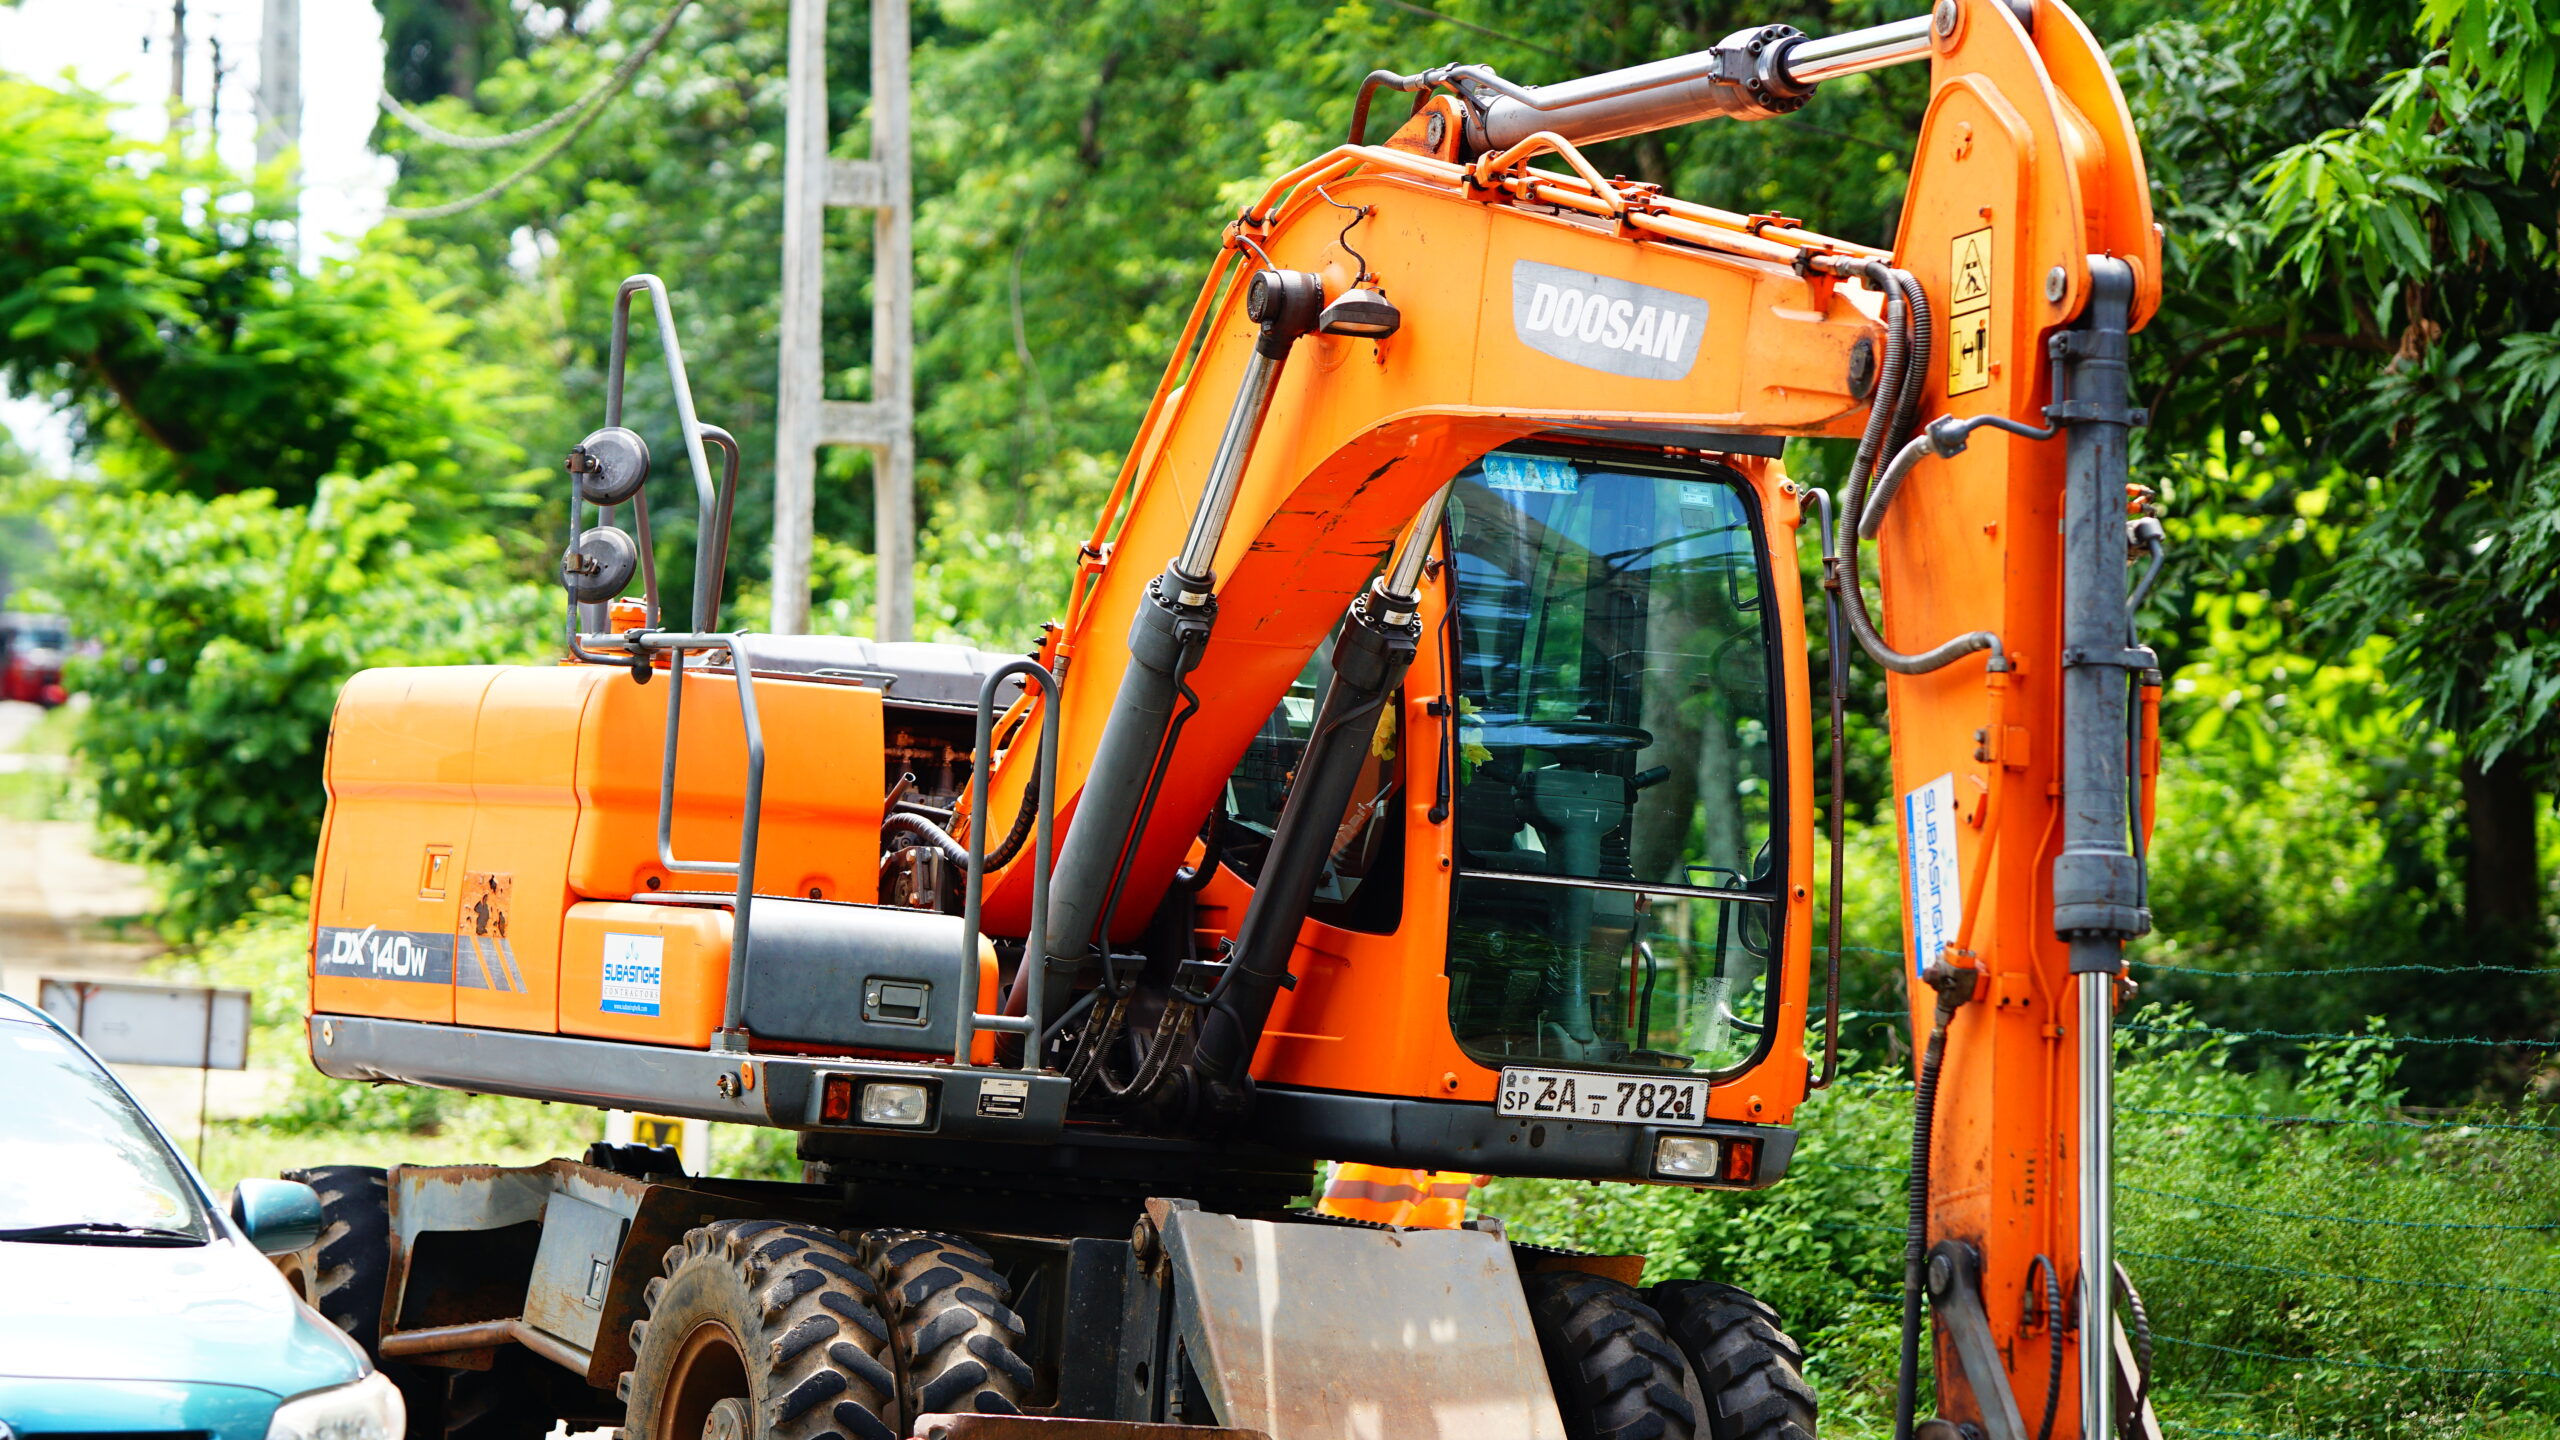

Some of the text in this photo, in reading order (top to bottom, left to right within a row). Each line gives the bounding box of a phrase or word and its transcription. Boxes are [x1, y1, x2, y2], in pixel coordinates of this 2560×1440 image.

[1525, 283, 1690, 362] DOOSAN
[604, 963, 660, 985] SUBASINGHE
[604, 986, 659, 1000] CONTRACTORS
[1503, 1091, 1529, 1111] SP
